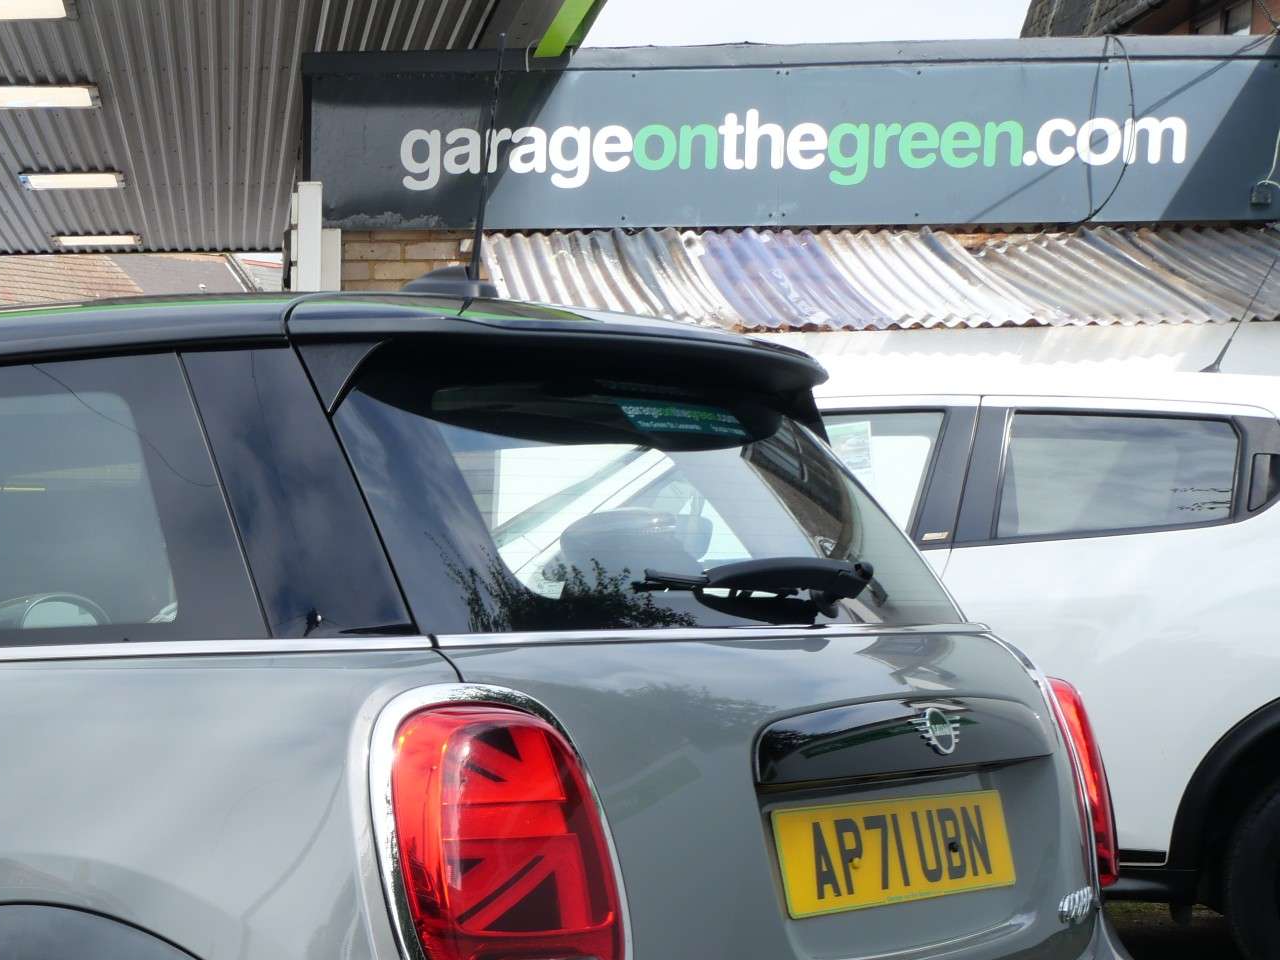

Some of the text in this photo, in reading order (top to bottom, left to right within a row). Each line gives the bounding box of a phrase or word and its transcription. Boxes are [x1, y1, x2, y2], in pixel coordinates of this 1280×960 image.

[400, 107, 1187, 191] garageonthegreen.com
[811, 804, 993, 900] AP71 UBN
